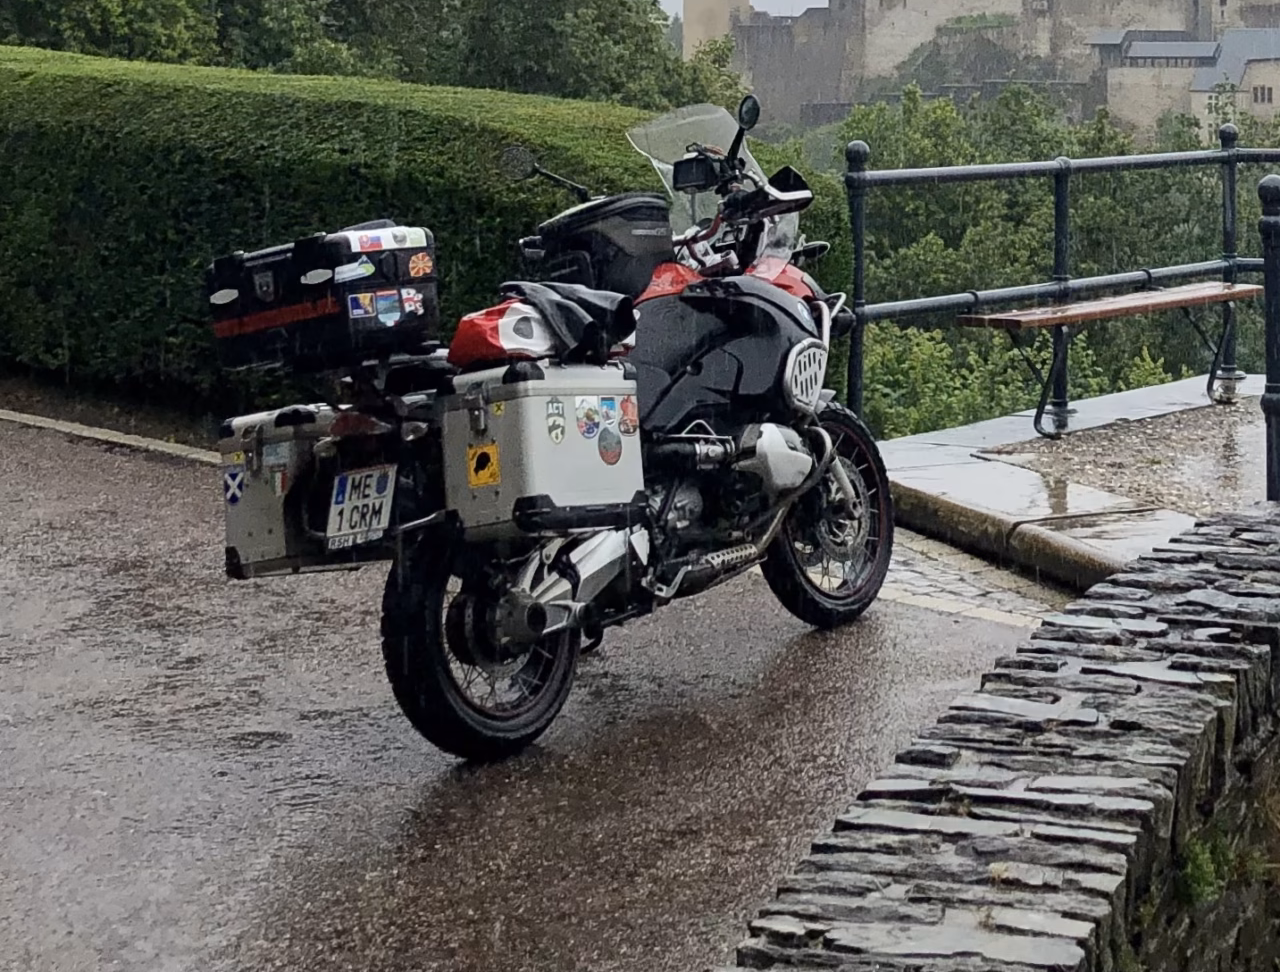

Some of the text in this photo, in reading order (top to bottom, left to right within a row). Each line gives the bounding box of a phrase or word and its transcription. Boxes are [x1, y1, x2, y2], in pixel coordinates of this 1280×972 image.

[548, 403, 563, 414] ACT
[348, 474, 374, 501] ME
[337, 500, 384, 532] 1 CRM
